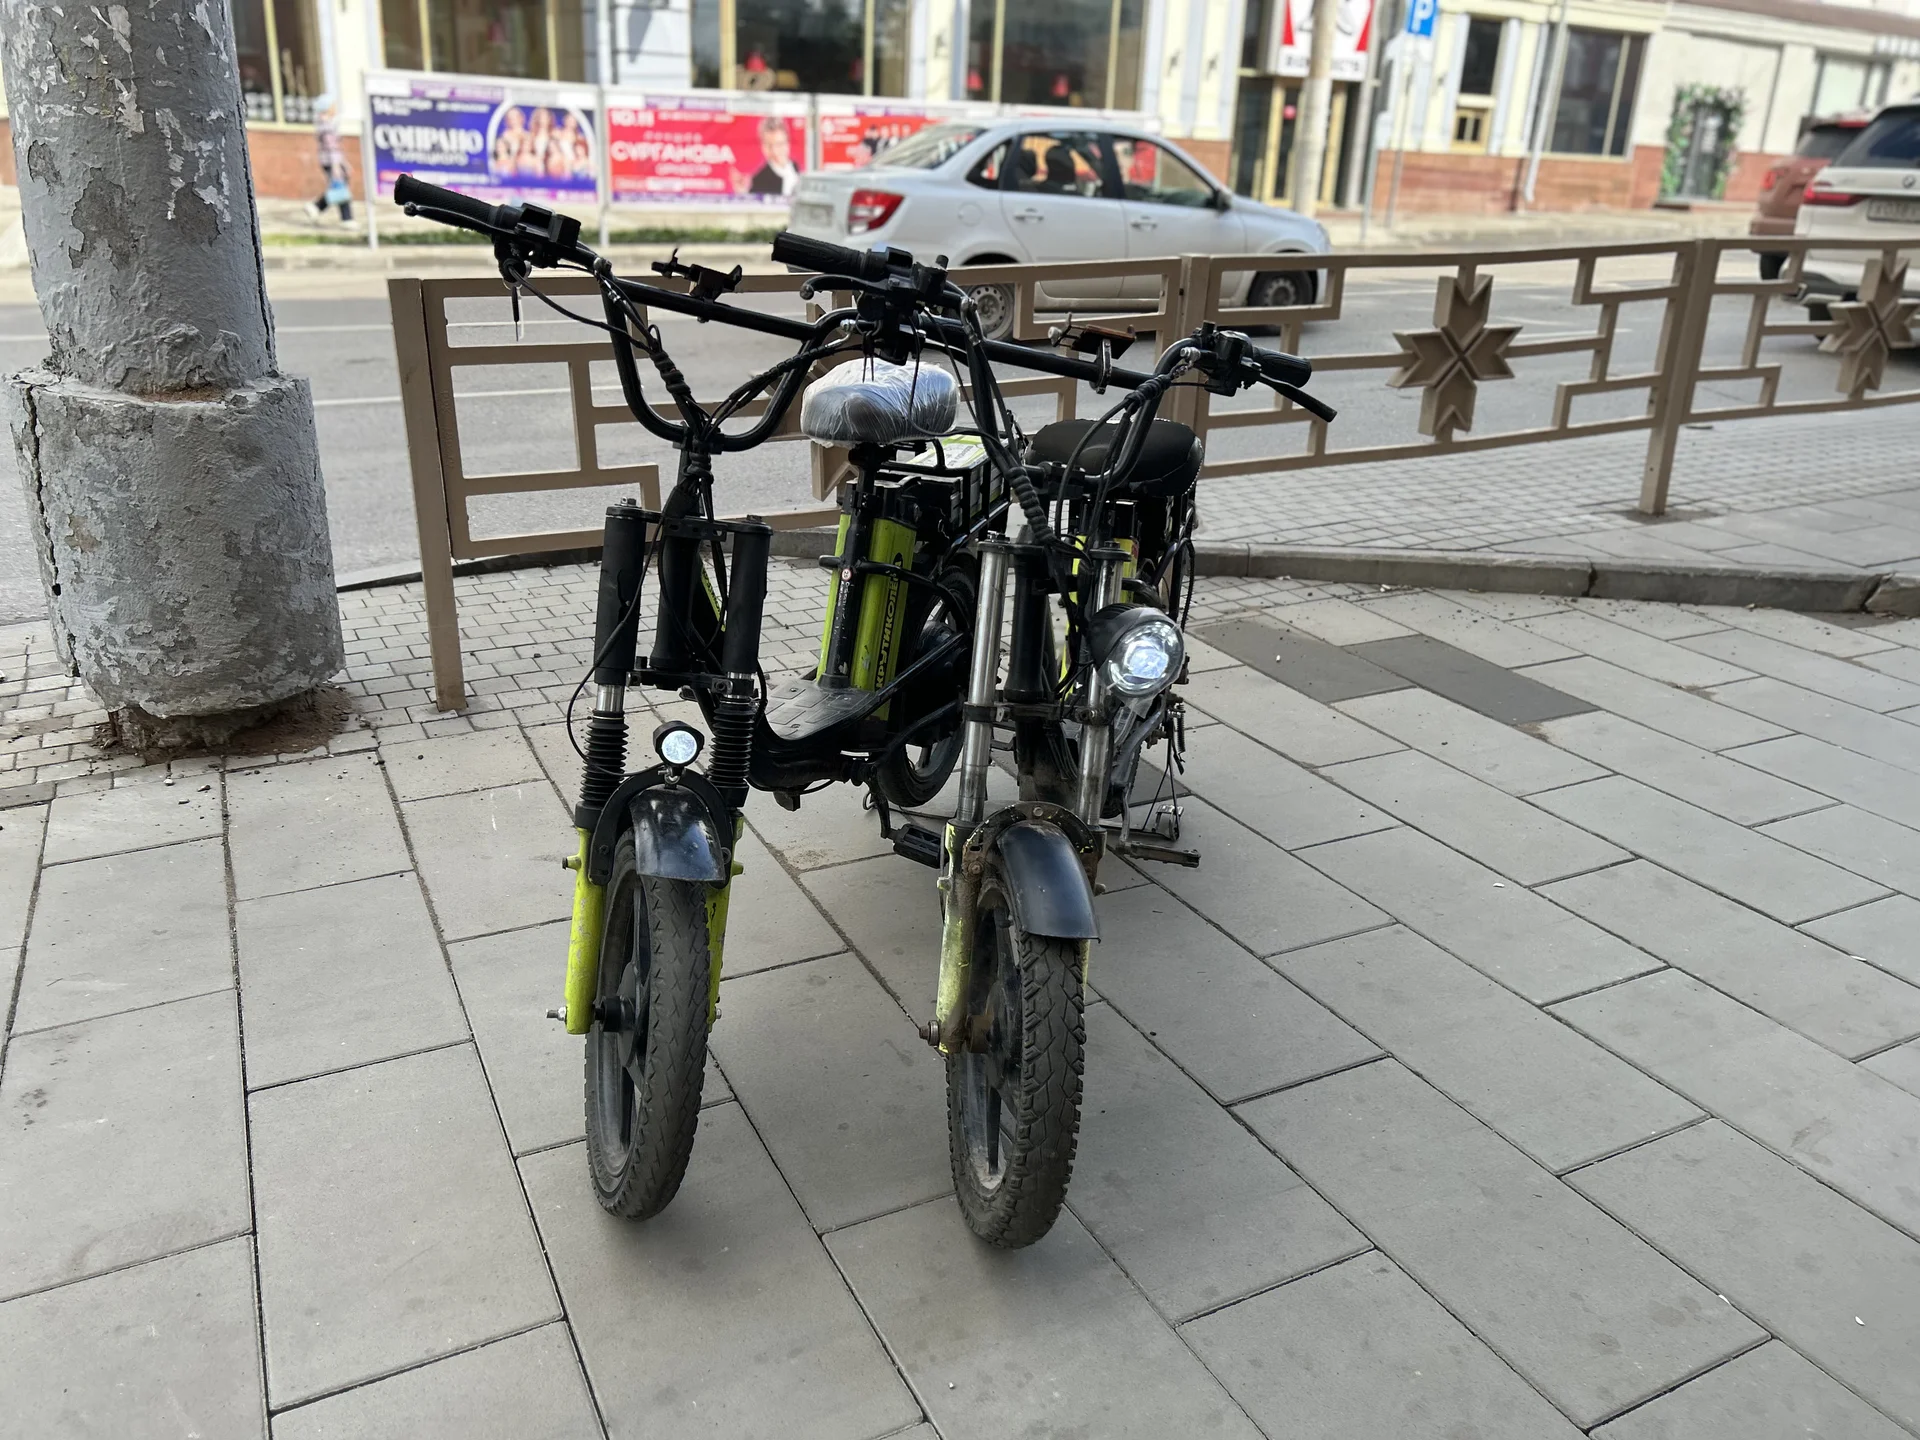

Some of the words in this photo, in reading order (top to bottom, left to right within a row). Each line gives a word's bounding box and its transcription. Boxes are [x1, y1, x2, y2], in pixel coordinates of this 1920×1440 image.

[1411, 0, 1434, 31] P
[374, 124, 484, 154] СОПРАНО
[610, 140, 736, 164] СУРГАНОВА
